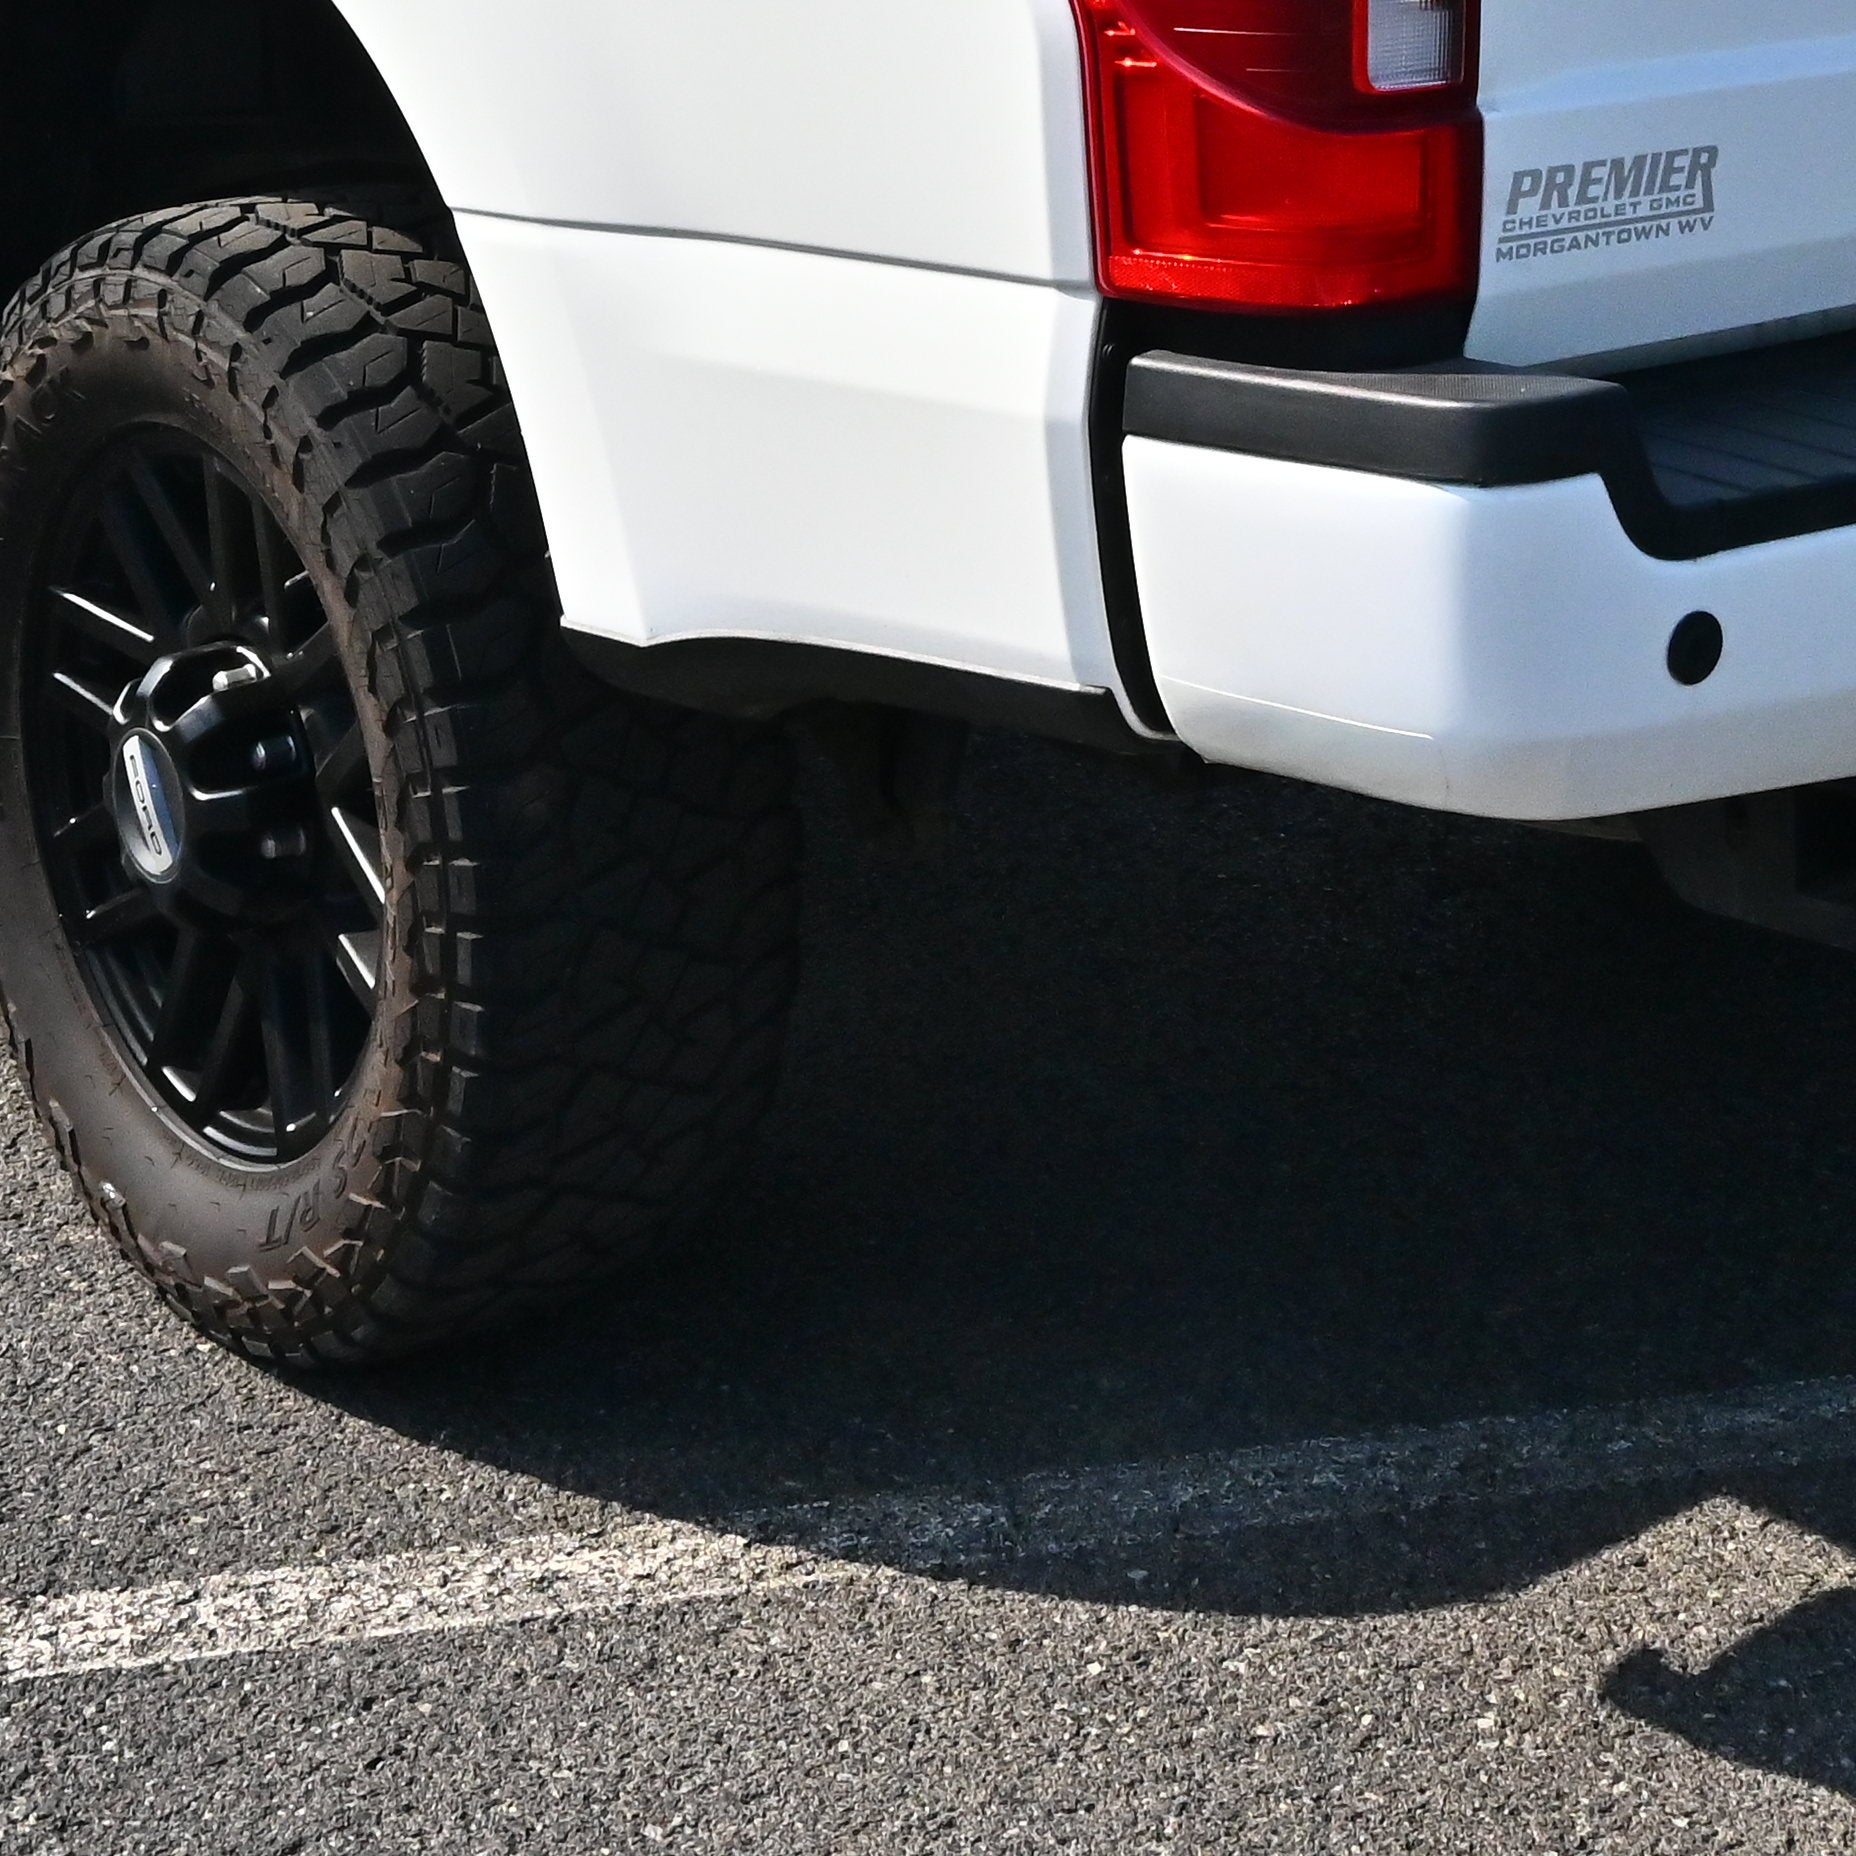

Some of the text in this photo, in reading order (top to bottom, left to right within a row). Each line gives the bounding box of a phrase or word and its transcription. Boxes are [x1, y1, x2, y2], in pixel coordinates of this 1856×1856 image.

[1505, 145, 1719, 216] PREMIER
[1495, 215, 1714, 263] MORGANTOWN WV
[1501, 193, 1696, 233] CHEVROLET GMC
[129, 754, 163, 856] FORD
